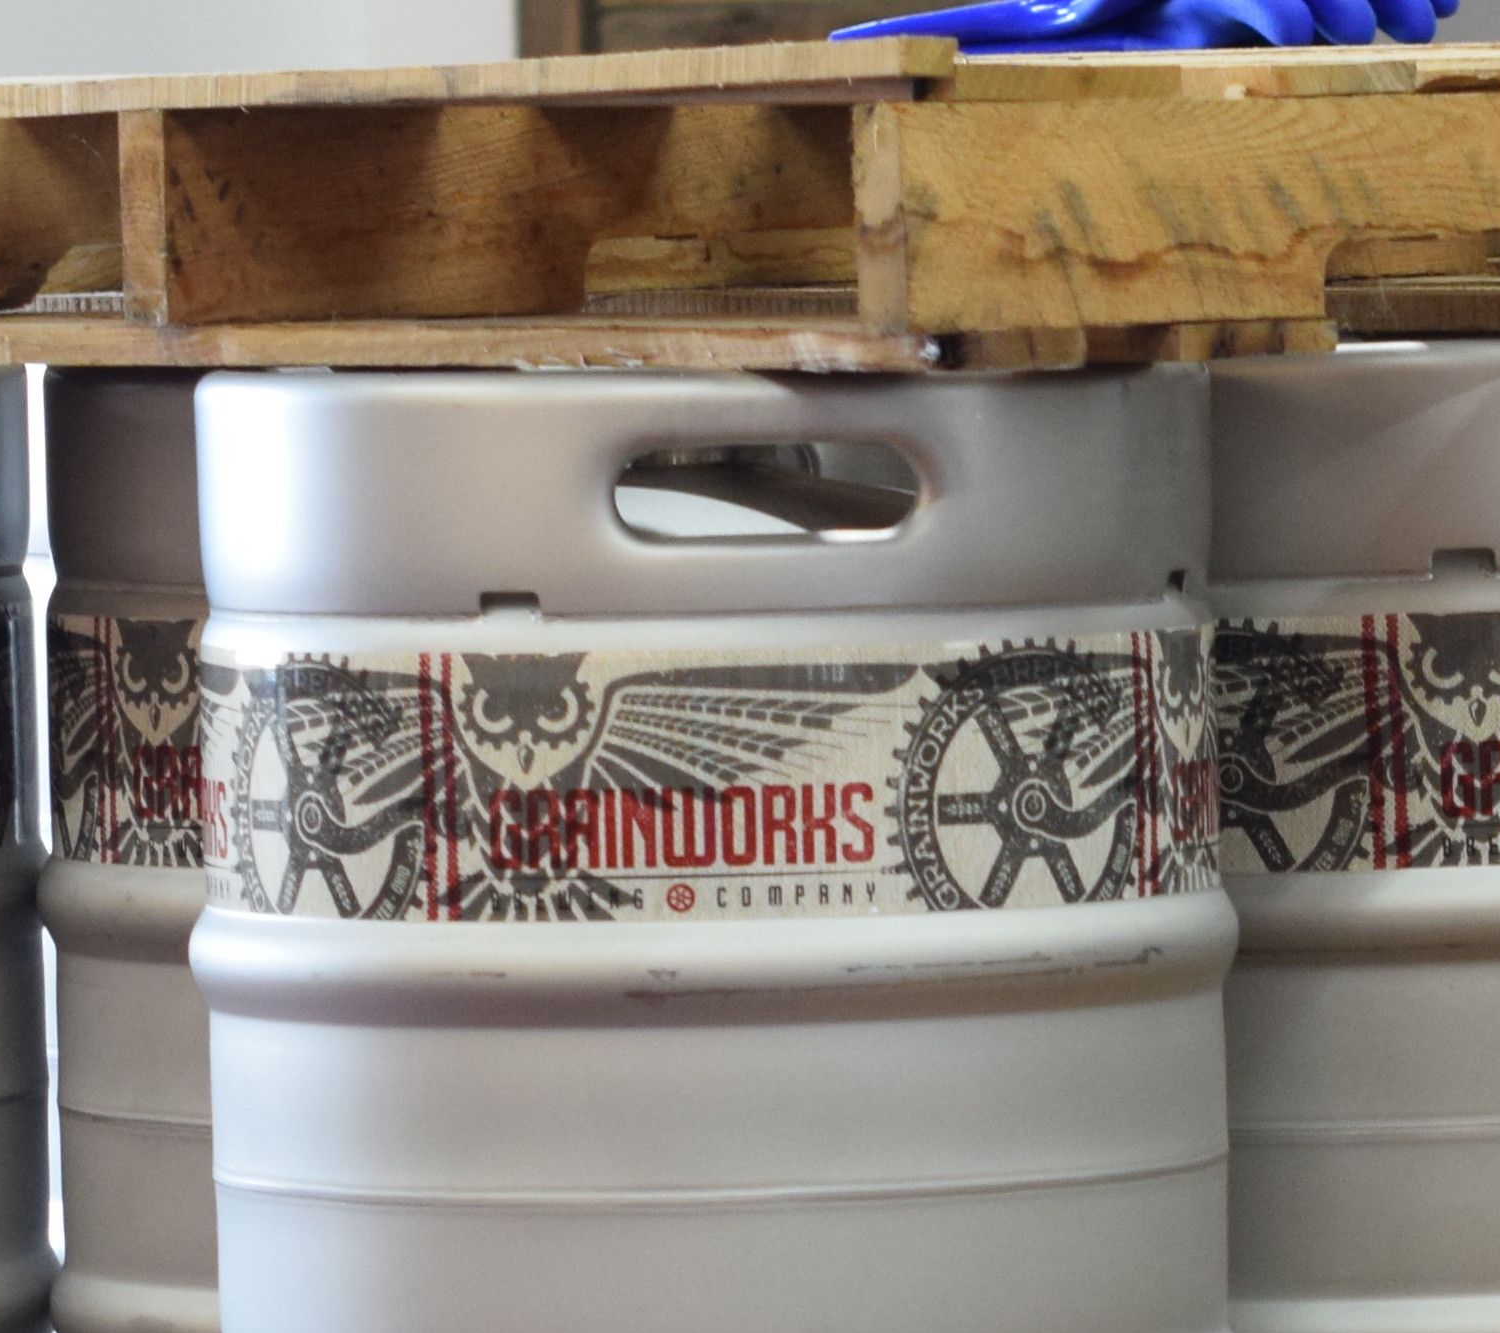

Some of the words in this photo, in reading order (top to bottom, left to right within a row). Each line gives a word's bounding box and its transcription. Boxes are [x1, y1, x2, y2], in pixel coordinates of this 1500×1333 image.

[489, 781, 876, 870] GRAINWORKS
[907, 688, 984, 910] GRAINWORKS
[490, 885, 644, 913] BREWING
[716, 882, 877, 910] COMPANY
